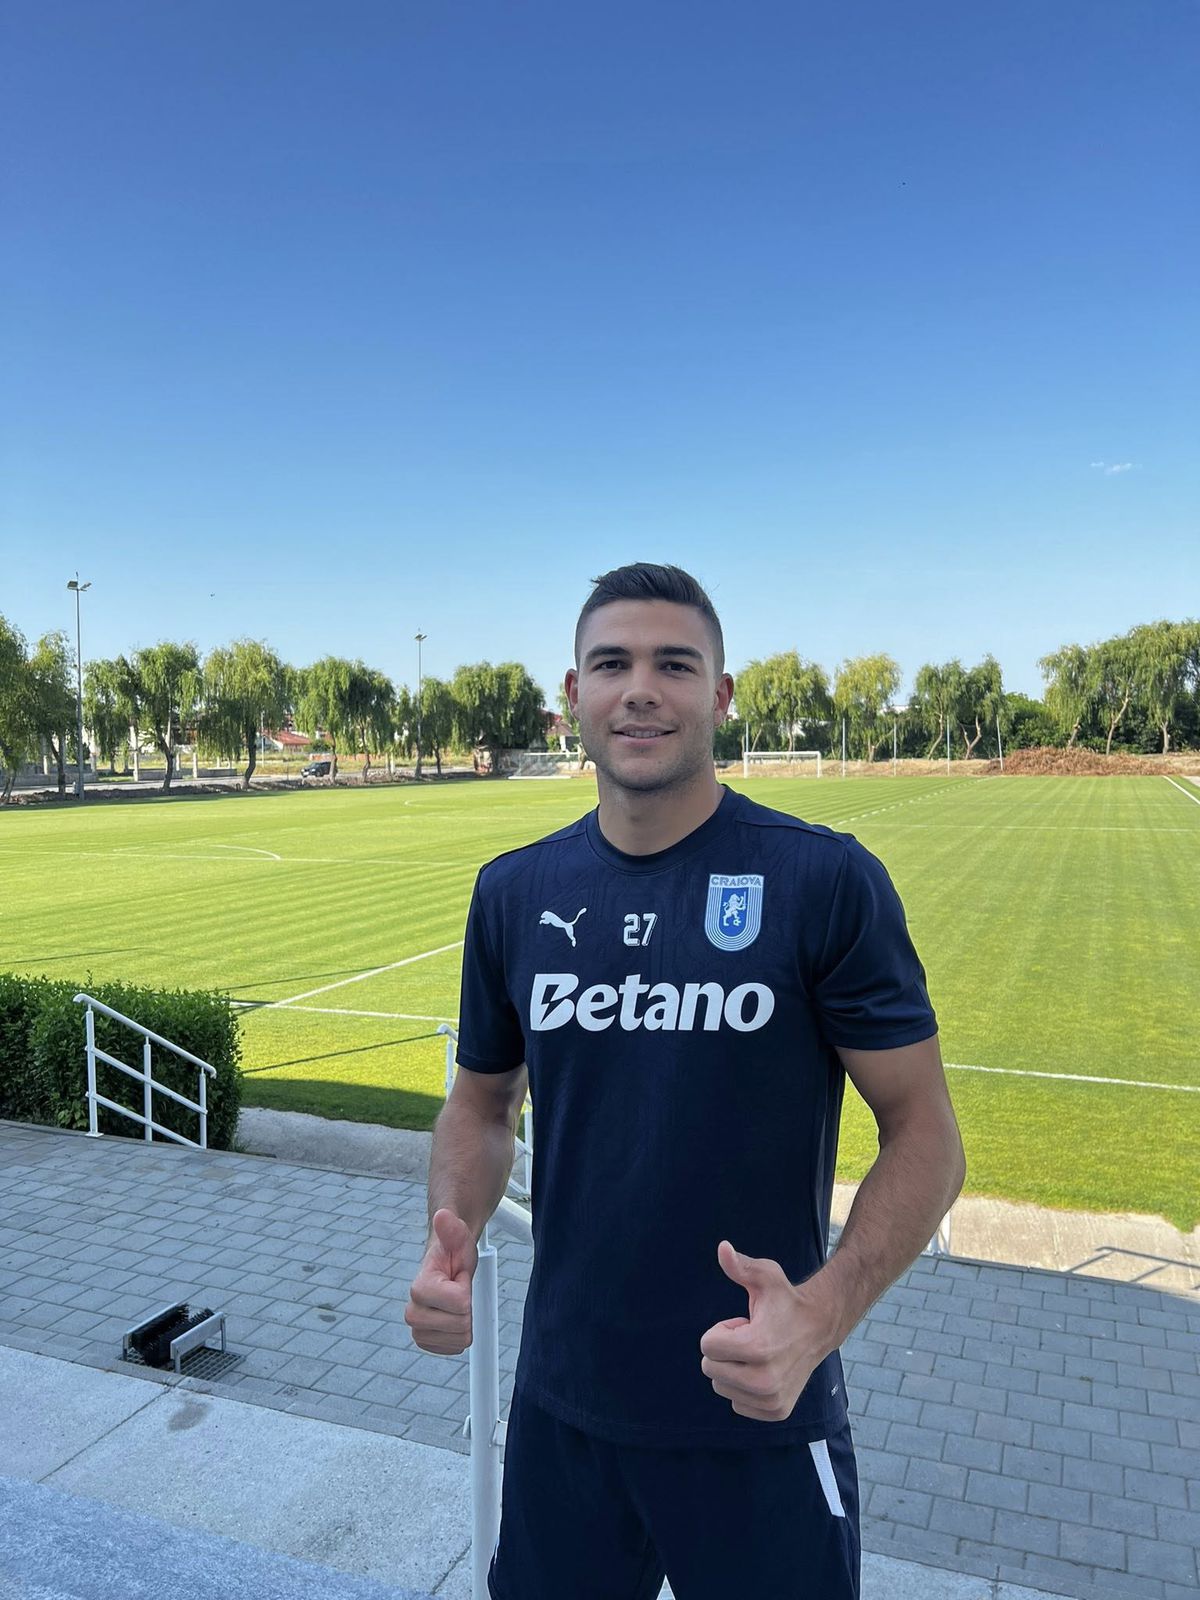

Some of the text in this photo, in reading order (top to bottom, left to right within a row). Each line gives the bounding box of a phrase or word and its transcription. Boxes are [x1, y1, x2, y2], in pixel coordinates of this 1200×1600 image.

[711, 876, 761, 886] CRAIOVA
[622, 912, 658, 947] 27
[529, 973, 775, 1032] Betano
